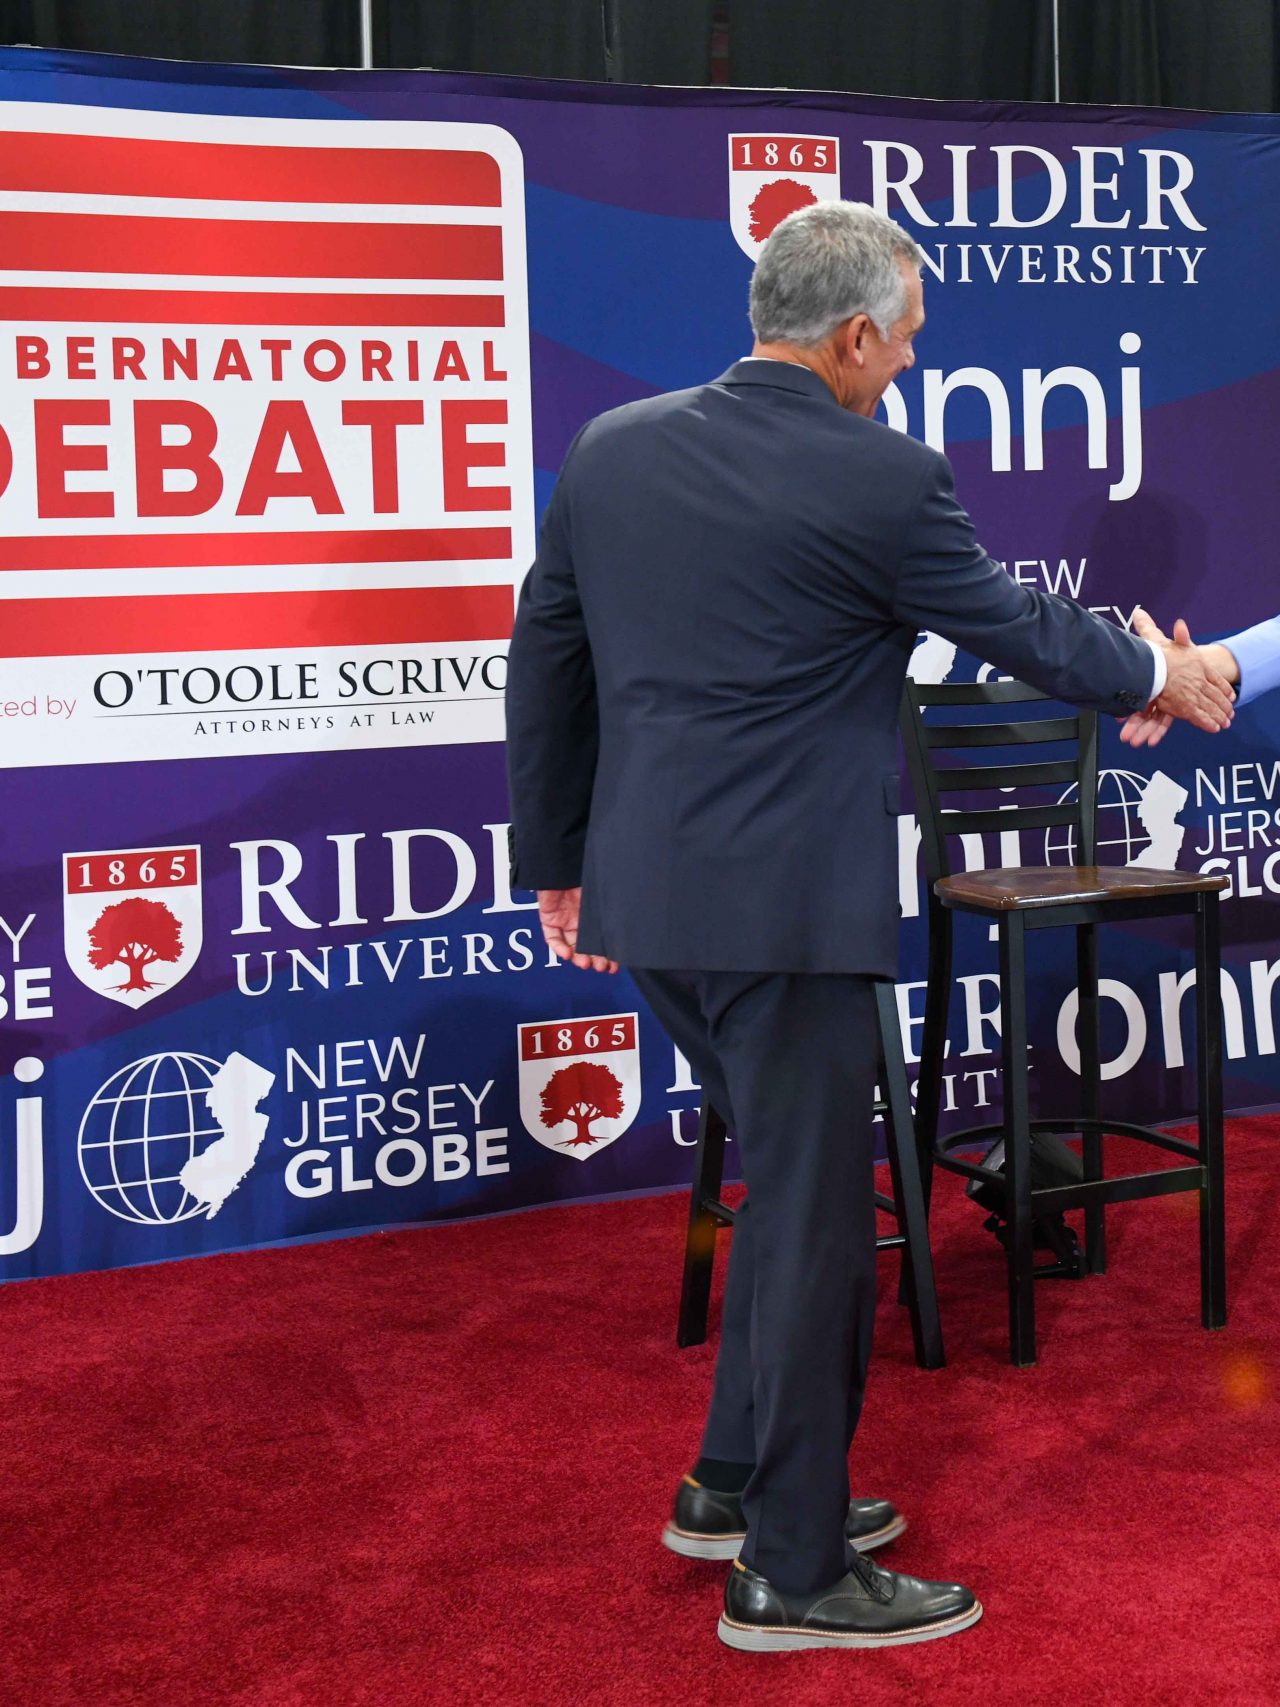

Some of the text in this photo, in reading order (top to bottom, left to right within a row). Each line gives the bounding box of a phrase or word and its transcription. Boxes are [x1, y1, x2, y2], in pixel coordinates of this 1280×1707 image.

[740, 141, 829, 168] 1865
[863, 140, 1207, 232] RIDER
[915, 243, 1207, 284] NIVERSITY
[0, 399, 512, 519] EBATE
[1001, 558, 1087, 599] EW
[93, 654, 508, 709] O'TOOLE SCRIVO
[47, 695, 77, 720] by
[78, 855, 187, 888] 1865
[531, 1023, 627, 1055] 1865
[286, 1034, 426, 1093] NEW
[283, 1080, 495, 1148] JERSEY
[284, 1127, 511, 1199] GLOBE
